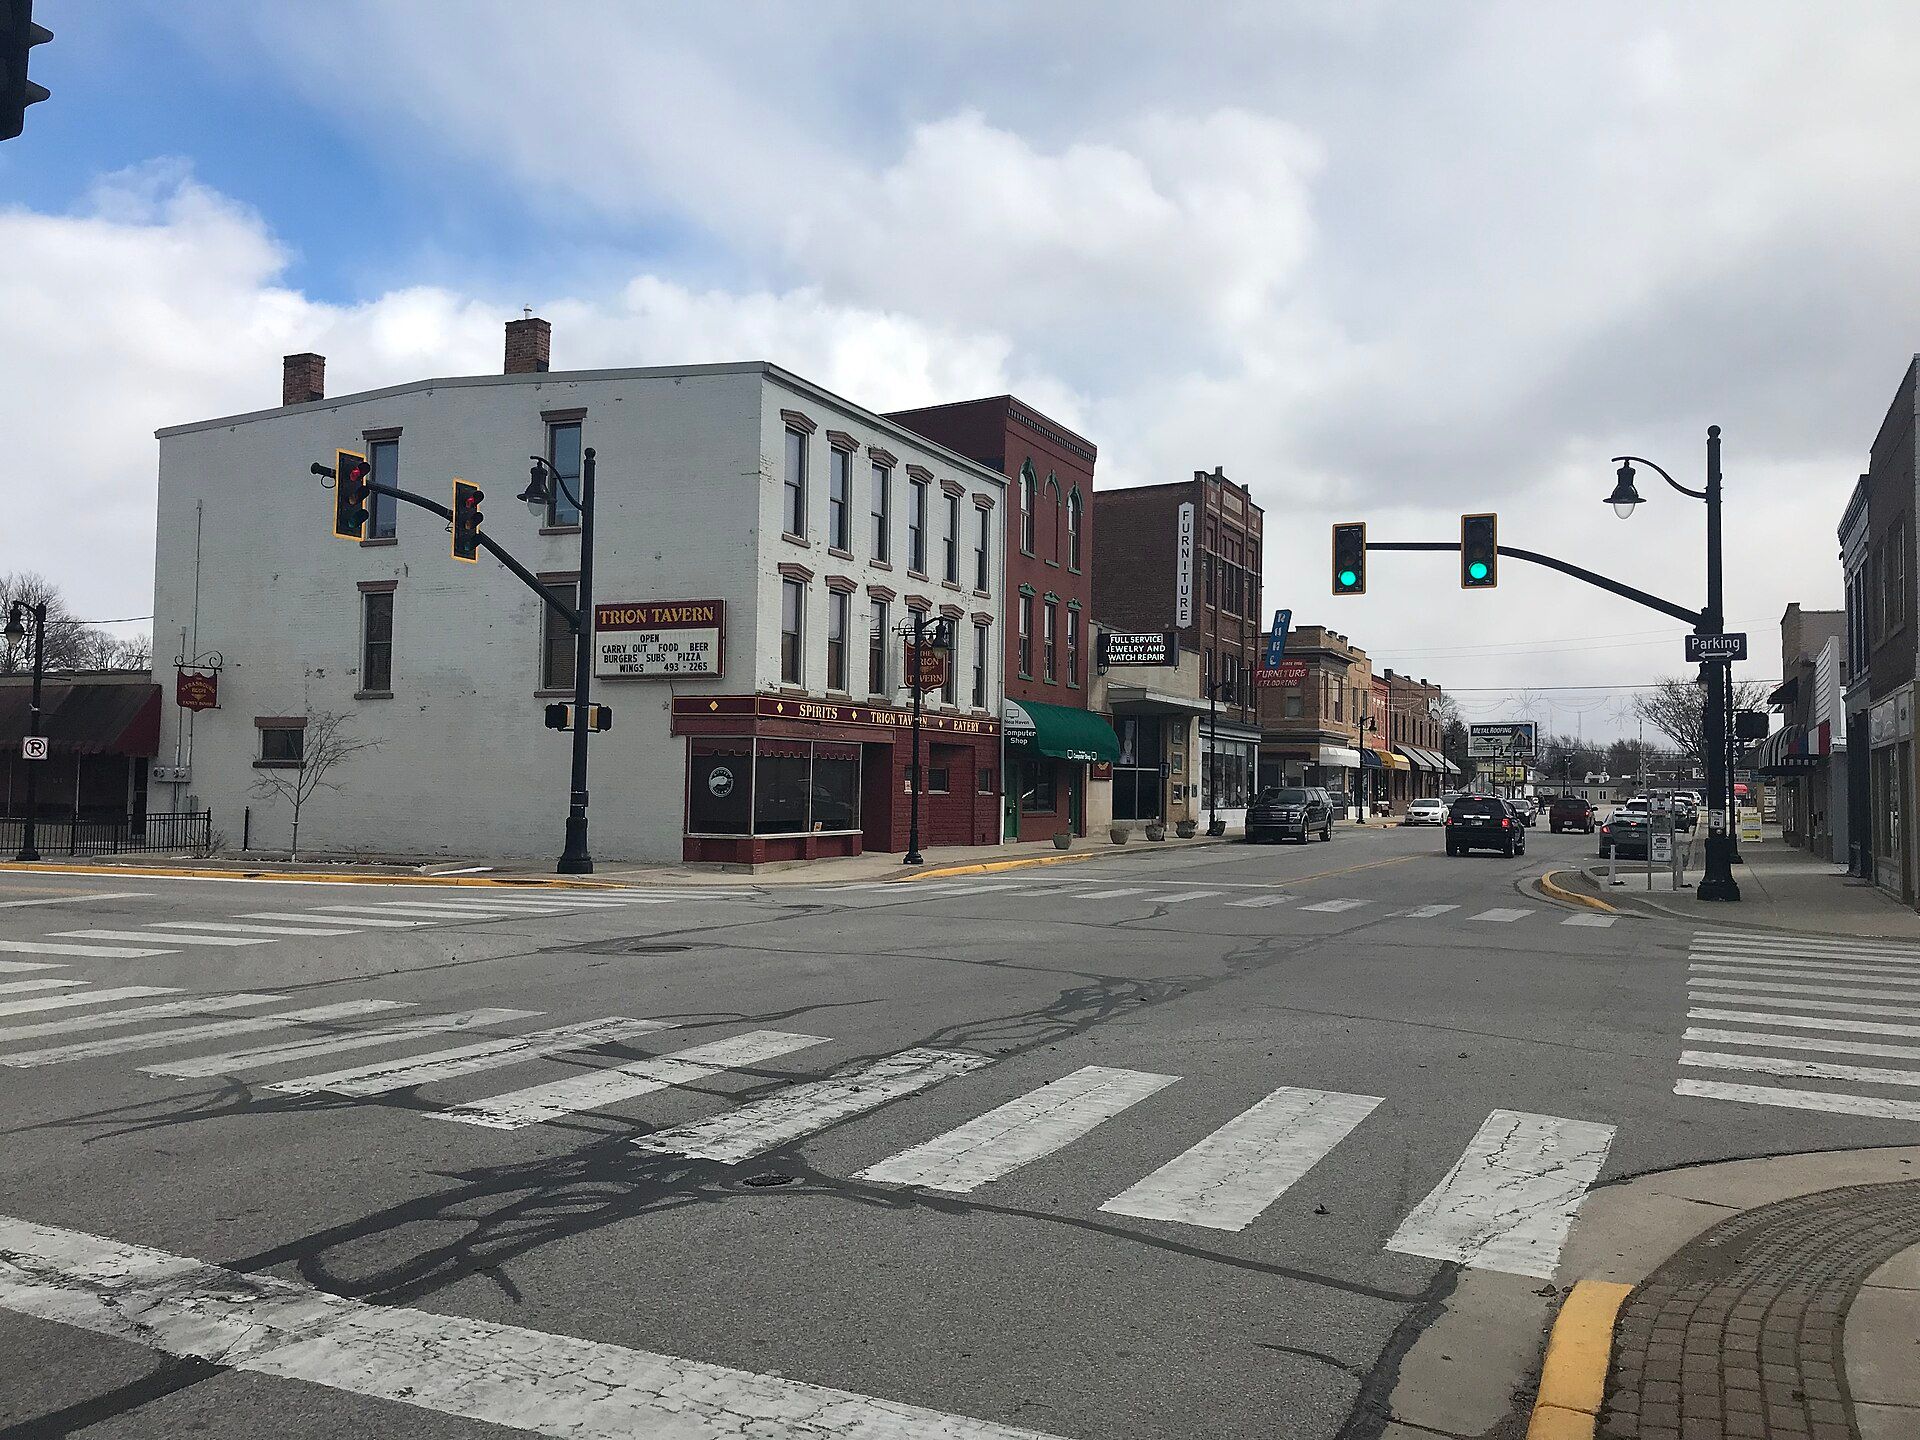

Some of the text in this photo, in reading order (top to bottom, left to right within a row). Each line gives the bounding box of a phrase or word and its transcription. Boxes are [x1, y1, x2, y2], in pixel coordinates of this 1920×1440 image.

[1180, 511, 1190, 620] FURNITURE
[600, 606, 714, 625] TRION TAVERN
[640, 634, 660, 643] OPEN
[1110, 635, 1162, 644] FULL SERVICE
[1691, 636, 1740, 652] Parking
[602, 642, 709, 654] CARRY OUT FOOD BEER
[1105, 645, 1166, 653] JEWELRY AND
[604, 652, 702, 664] BURGERS SUBS PIZZA
[1107, 653, 1165, 661] WATCH REPAIR
[619, 663, 644, 673] WINGS
[663, 662, 679, 672] 493
[689, 662, 708, 671] 2265
[908, 674, 943, 683] TVERN
[1256, 668, 1307, 679] FURNITURE
[799, 703, 838, 720] SPIRITS
[871, 711, 928, 727] TRION TAVRN
[953, 720, 980, 733] EATERY
[1004, 729, 1037, 737] Computer
[1010, 737, 1028, 745] Shop
